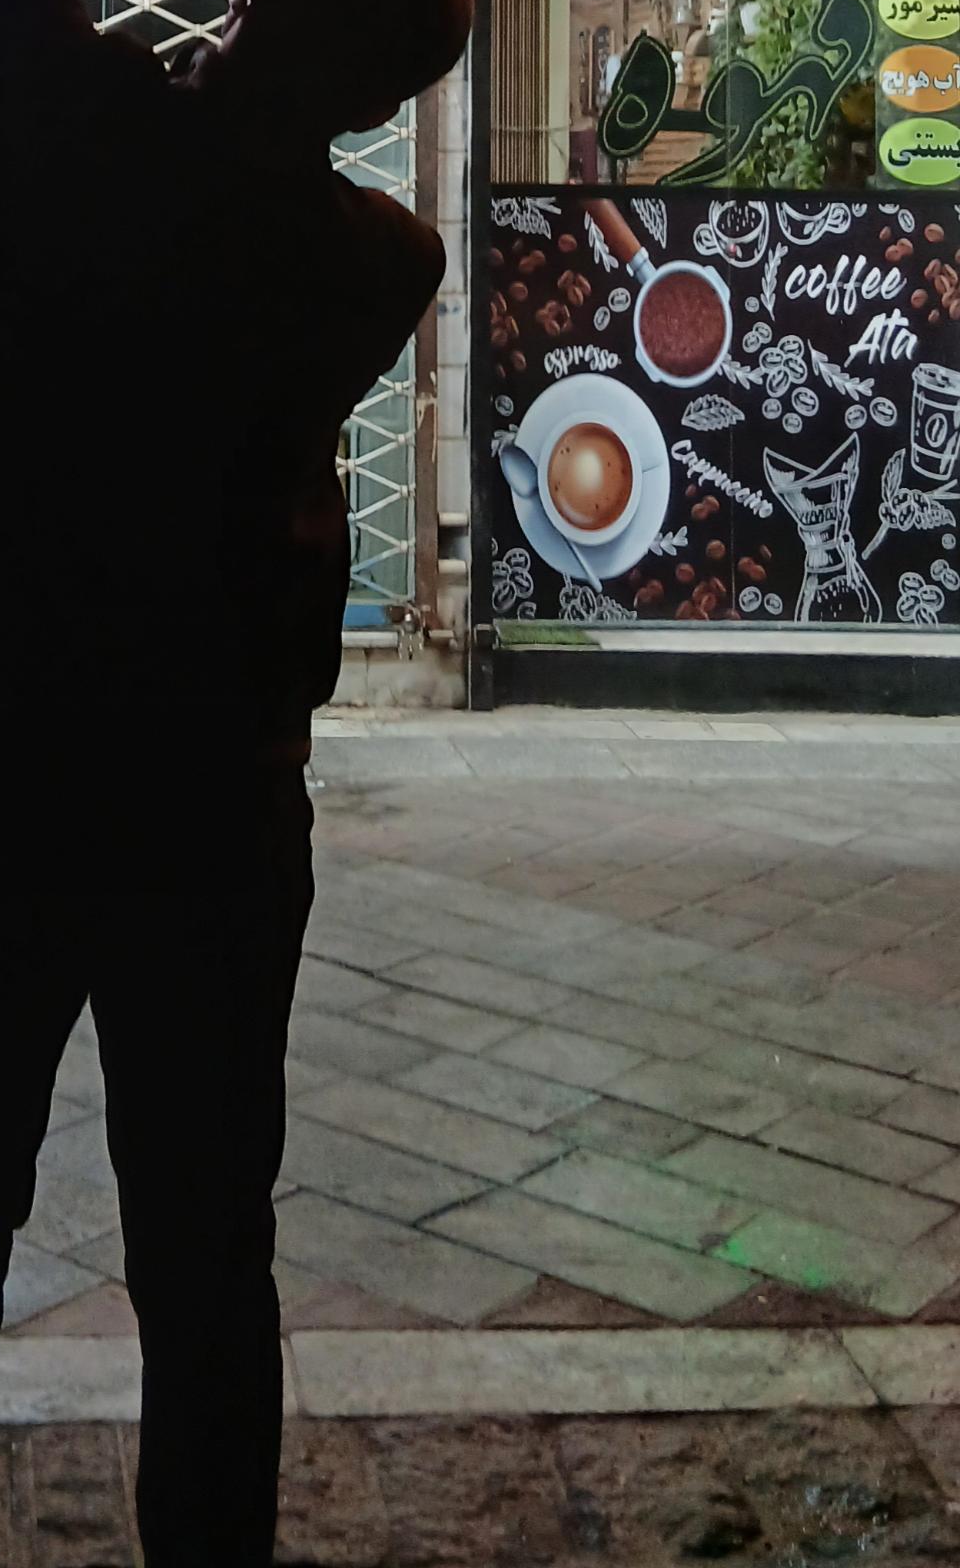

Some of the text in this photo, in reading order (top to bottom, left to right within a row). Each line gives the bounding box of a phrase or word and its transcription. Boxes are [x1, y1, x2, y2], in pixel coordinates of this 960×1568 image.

[881, 69, 930, 96] هویج
[785, 254, 907, 315] coffee
[844, 308, 917, 368] Ata
